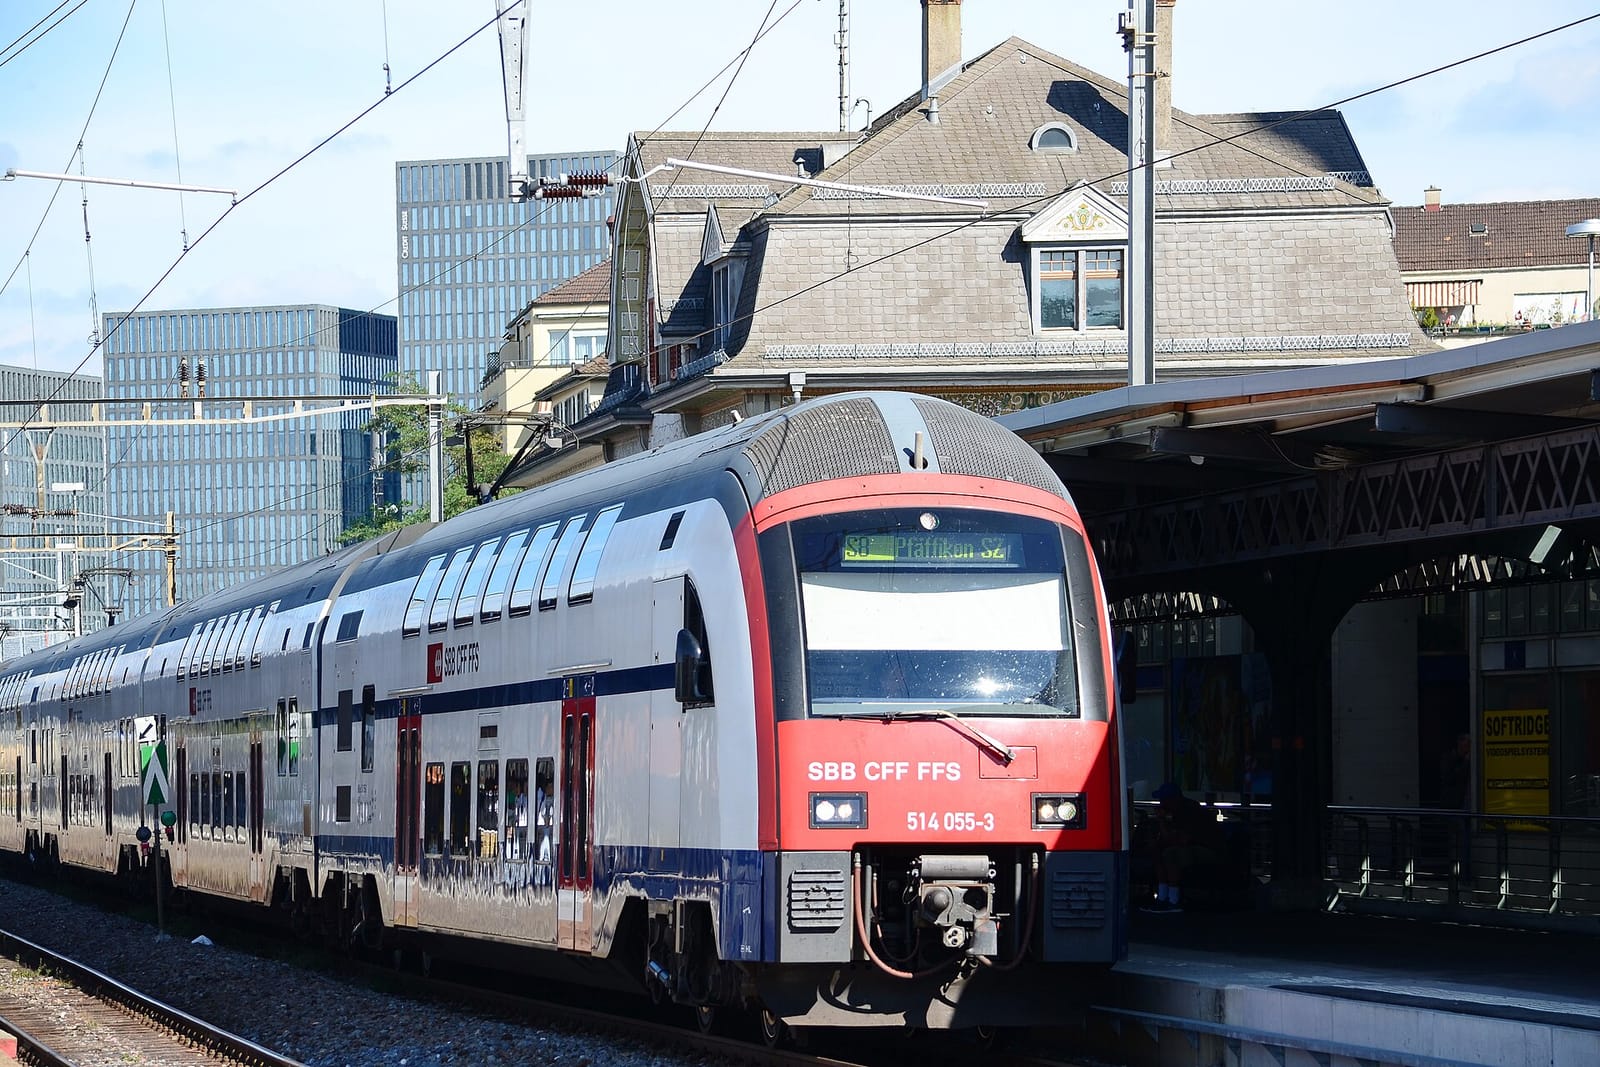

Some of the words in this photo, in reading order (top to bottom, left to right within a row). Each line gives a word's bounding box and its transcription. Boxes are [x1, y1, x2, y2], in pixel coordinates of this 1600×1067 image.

[981, 538, 1005, 559] SZ
[444, 647, 455, 677] SBB
[456, 644, 467, 676] CFF
[469, 641, 480, 673] FFS
[1485, 714, 1550, 736] SOFTRIDGE
[807, 761, 857, 781] SBB
[863, 761, 910, 781] CFF
[917, 761, 962, 781] FFS
[906, 811, 940, 831] 514
[943, 811, 995, 832] 055-3
